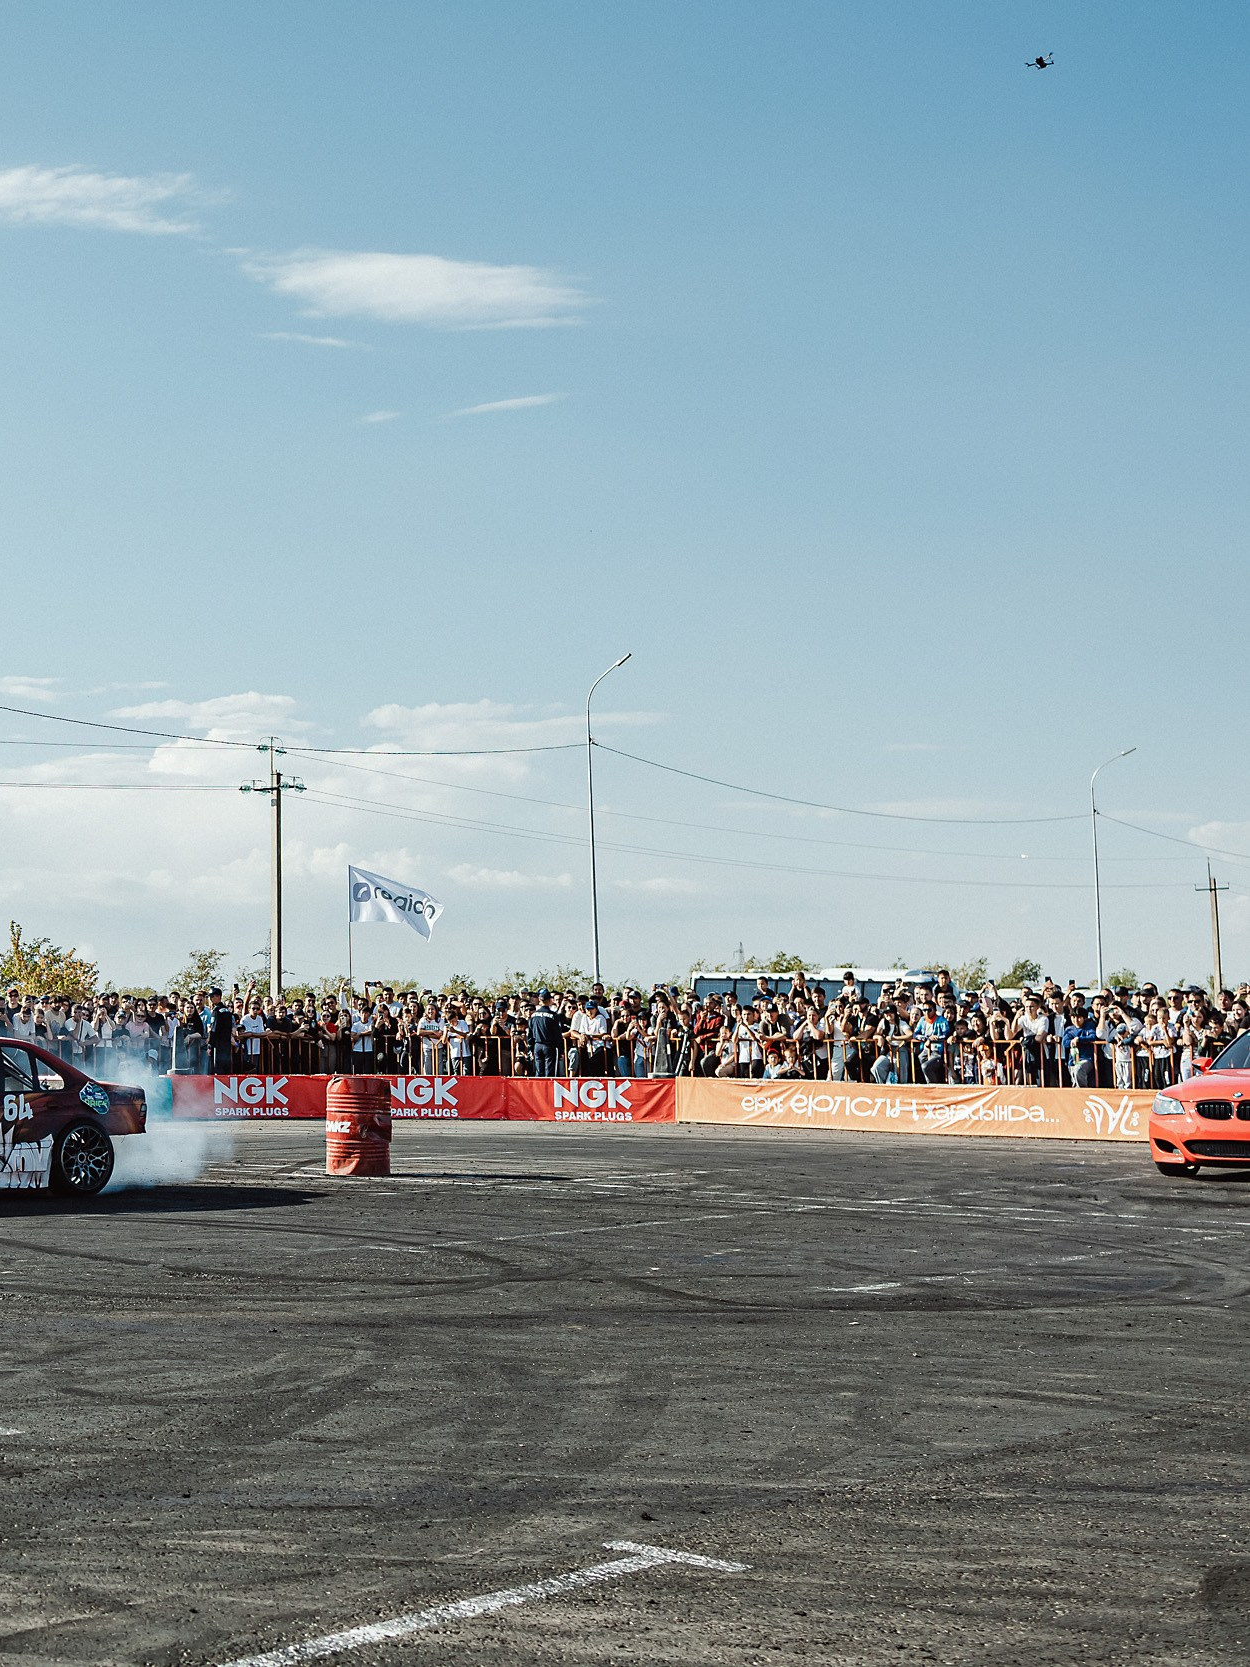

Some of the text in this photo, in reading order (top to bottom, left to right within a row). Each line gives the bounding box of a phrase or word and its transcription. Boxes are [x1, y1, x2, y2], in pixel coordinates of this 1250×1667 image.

[213, 1076, 289, 1105] NGK
[553, 1079, 633, 1110] NGK
[3, 1093, 34, 1122] 64
[215, 1107, 289, 1116] SPARK PLUGS
[390, 1108, 459, 1118] PARK PLUGS
[554, 1111, 633, 1122] SPARK PLUGS
